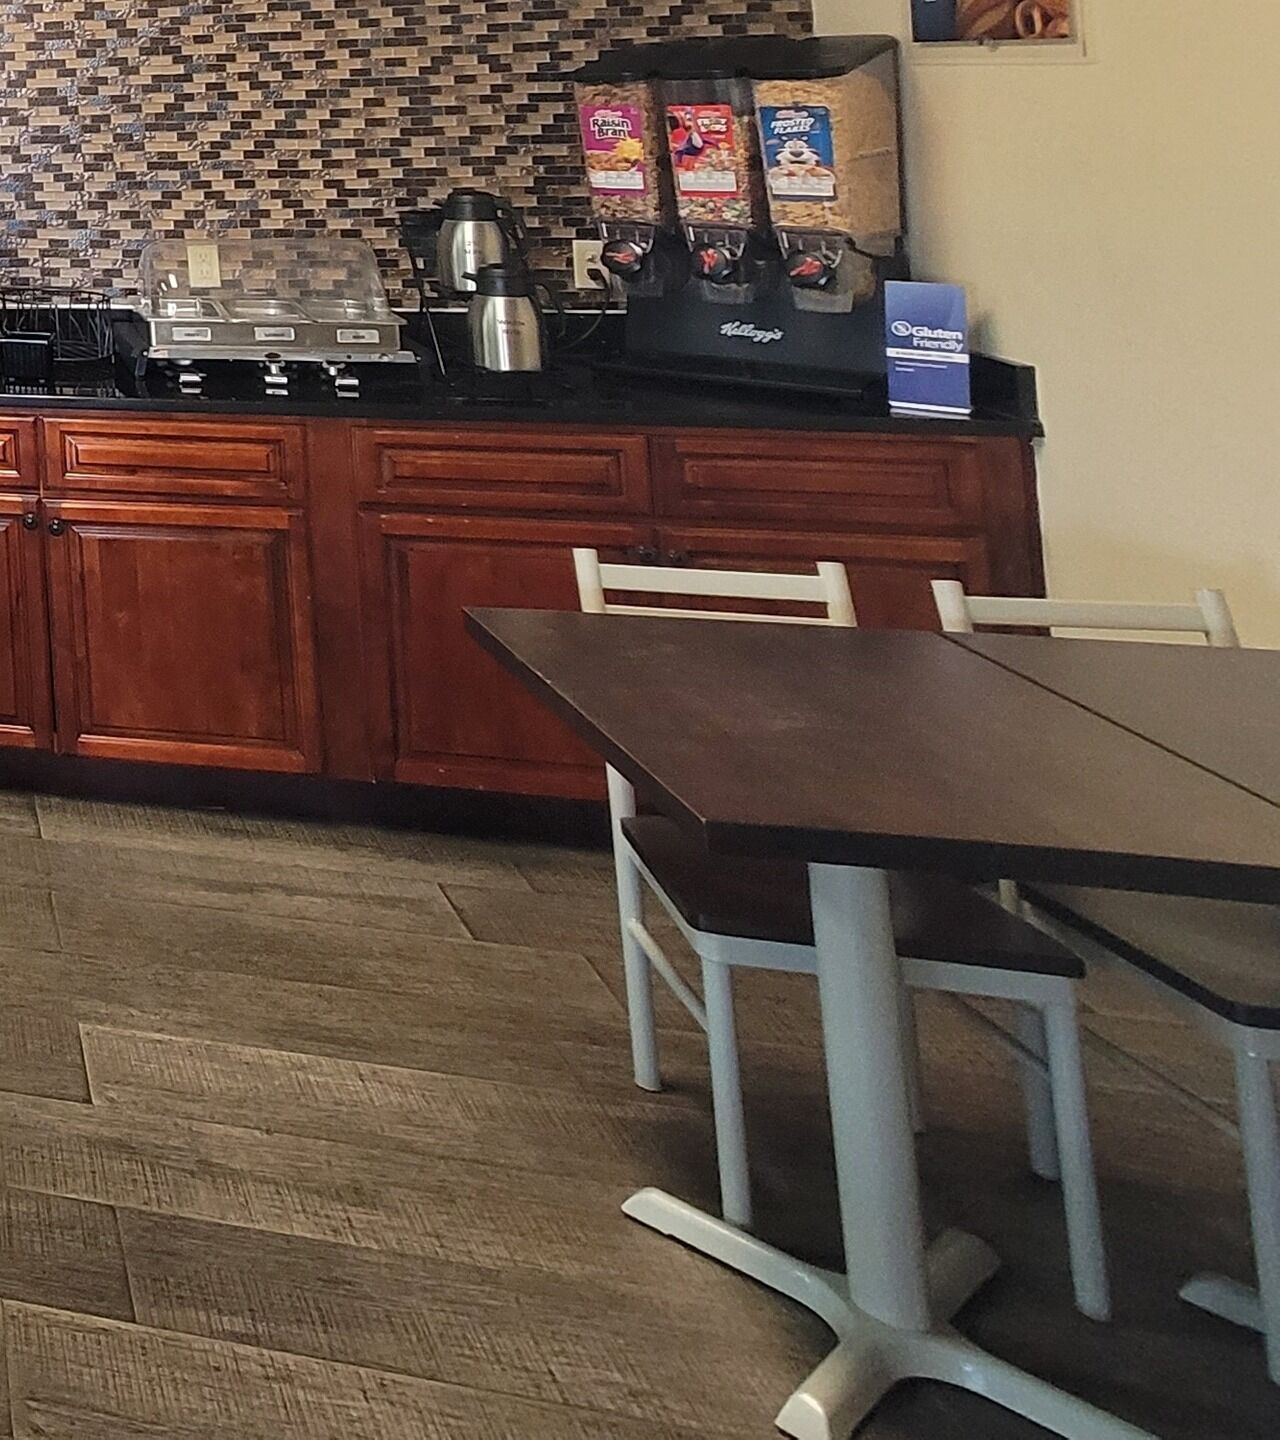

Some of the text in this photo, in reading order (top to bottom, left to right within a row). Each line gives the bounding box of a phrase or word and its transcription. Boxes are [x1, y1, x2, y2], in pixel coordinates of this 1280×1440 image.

[592, 118, 629, 130] Raisin
[597, 128, 626, 138] Bran
[720, 321, 784, 343] Kellogg's
[912, 326, 963, 340] Gluten
[912, 337, 964, 353] Friendly
